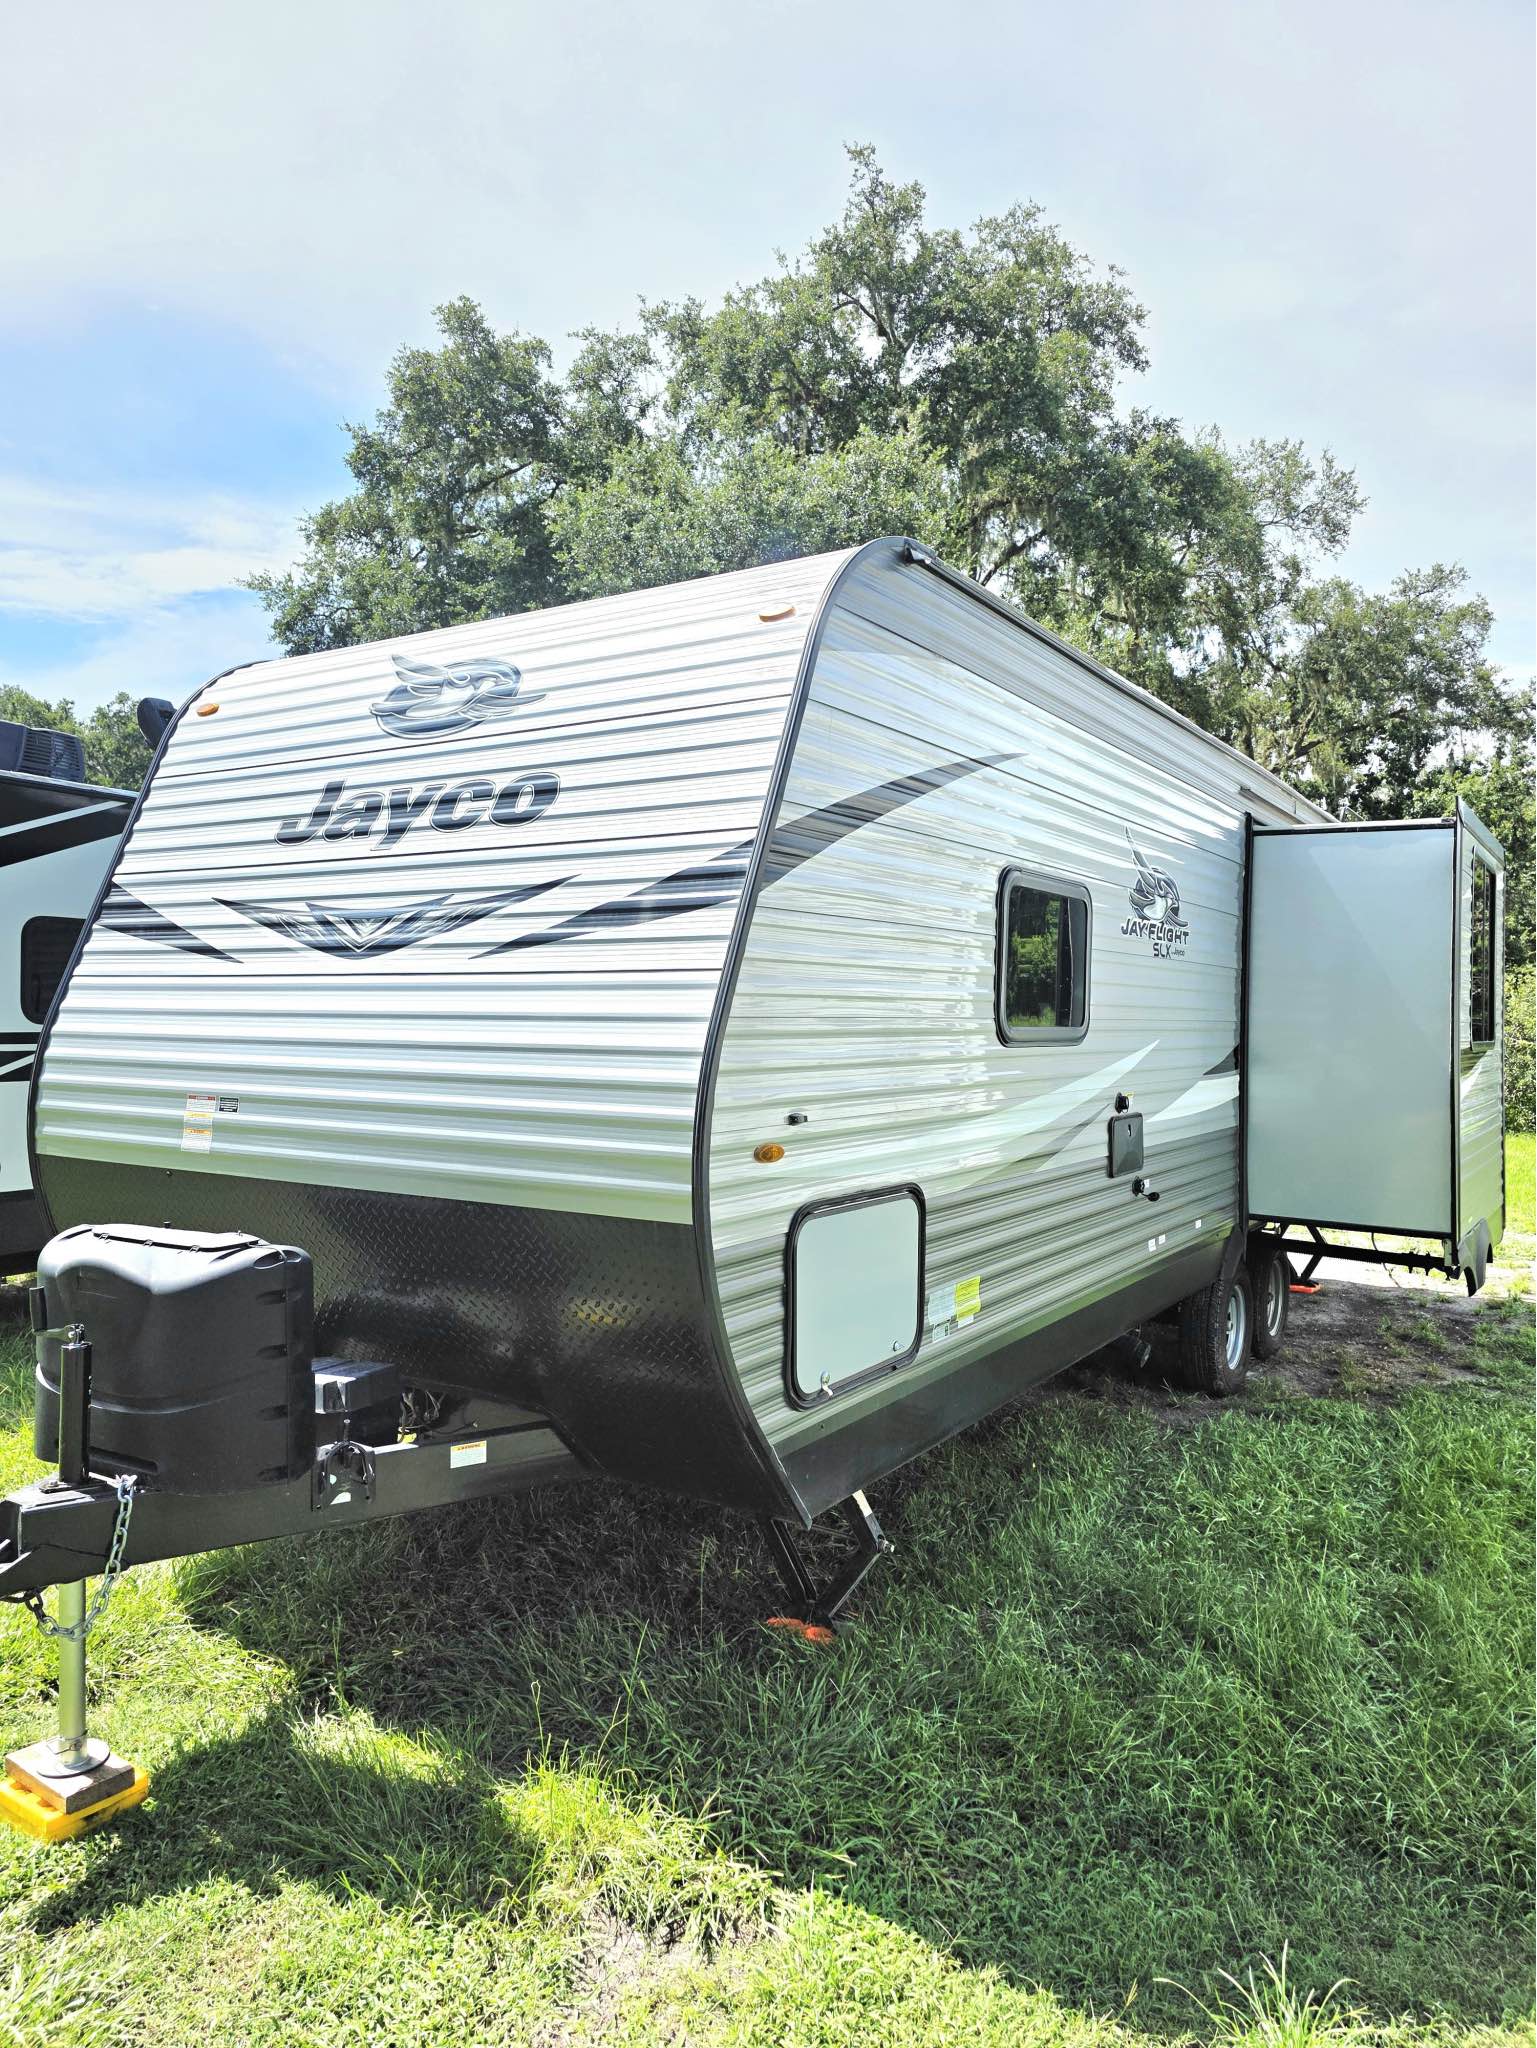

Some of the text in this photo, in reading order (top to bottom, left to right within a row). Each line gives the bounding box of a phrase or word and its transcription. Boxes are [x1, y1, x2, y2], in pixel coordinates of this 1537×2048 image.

[274, 771, 561, 851] Jayco
[1121, 918, 1190, 944] JAY FLIGHT
[1152, 942, 1172, 959] SLX
